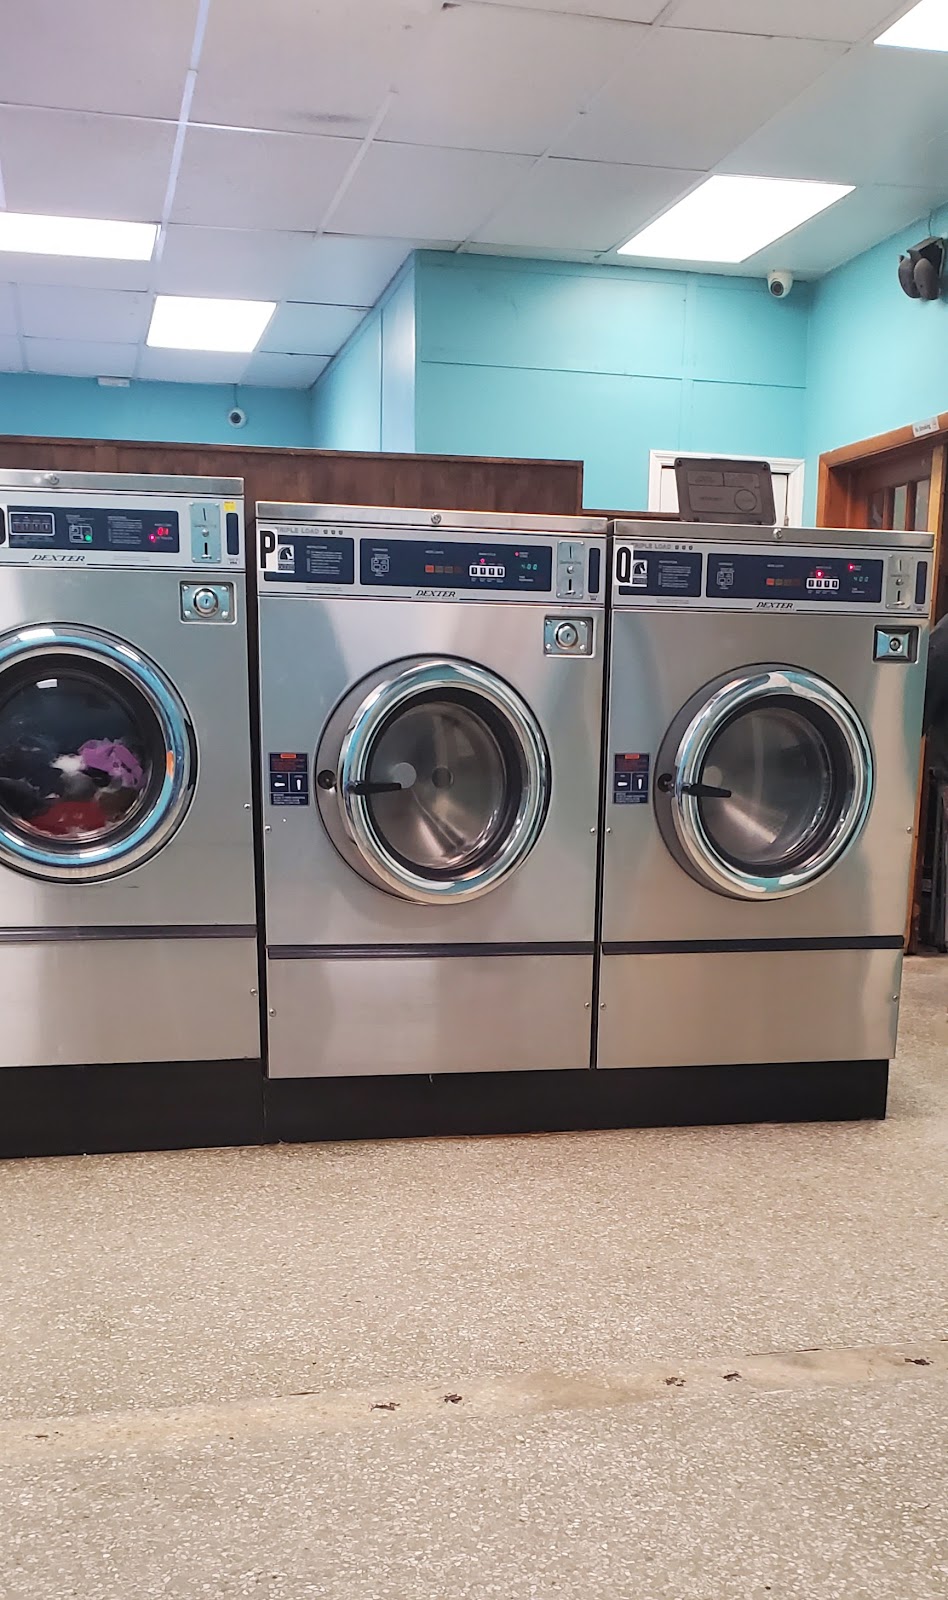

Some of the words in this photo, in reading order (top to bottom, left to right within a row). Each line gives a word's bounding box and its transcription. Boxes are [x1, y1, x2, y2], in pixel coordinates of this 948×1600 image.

[301, 527, 320, 536] LOAD
[260, 531, 275, 568] P
[655, 543, 672, 551] LOAD
[32, 554, 86, 562] DEXTER
[616, 547, 631, 583] Q
[415, 589, 456, 598] DEXTER
[756, 601, 794, 609] DEXTER
